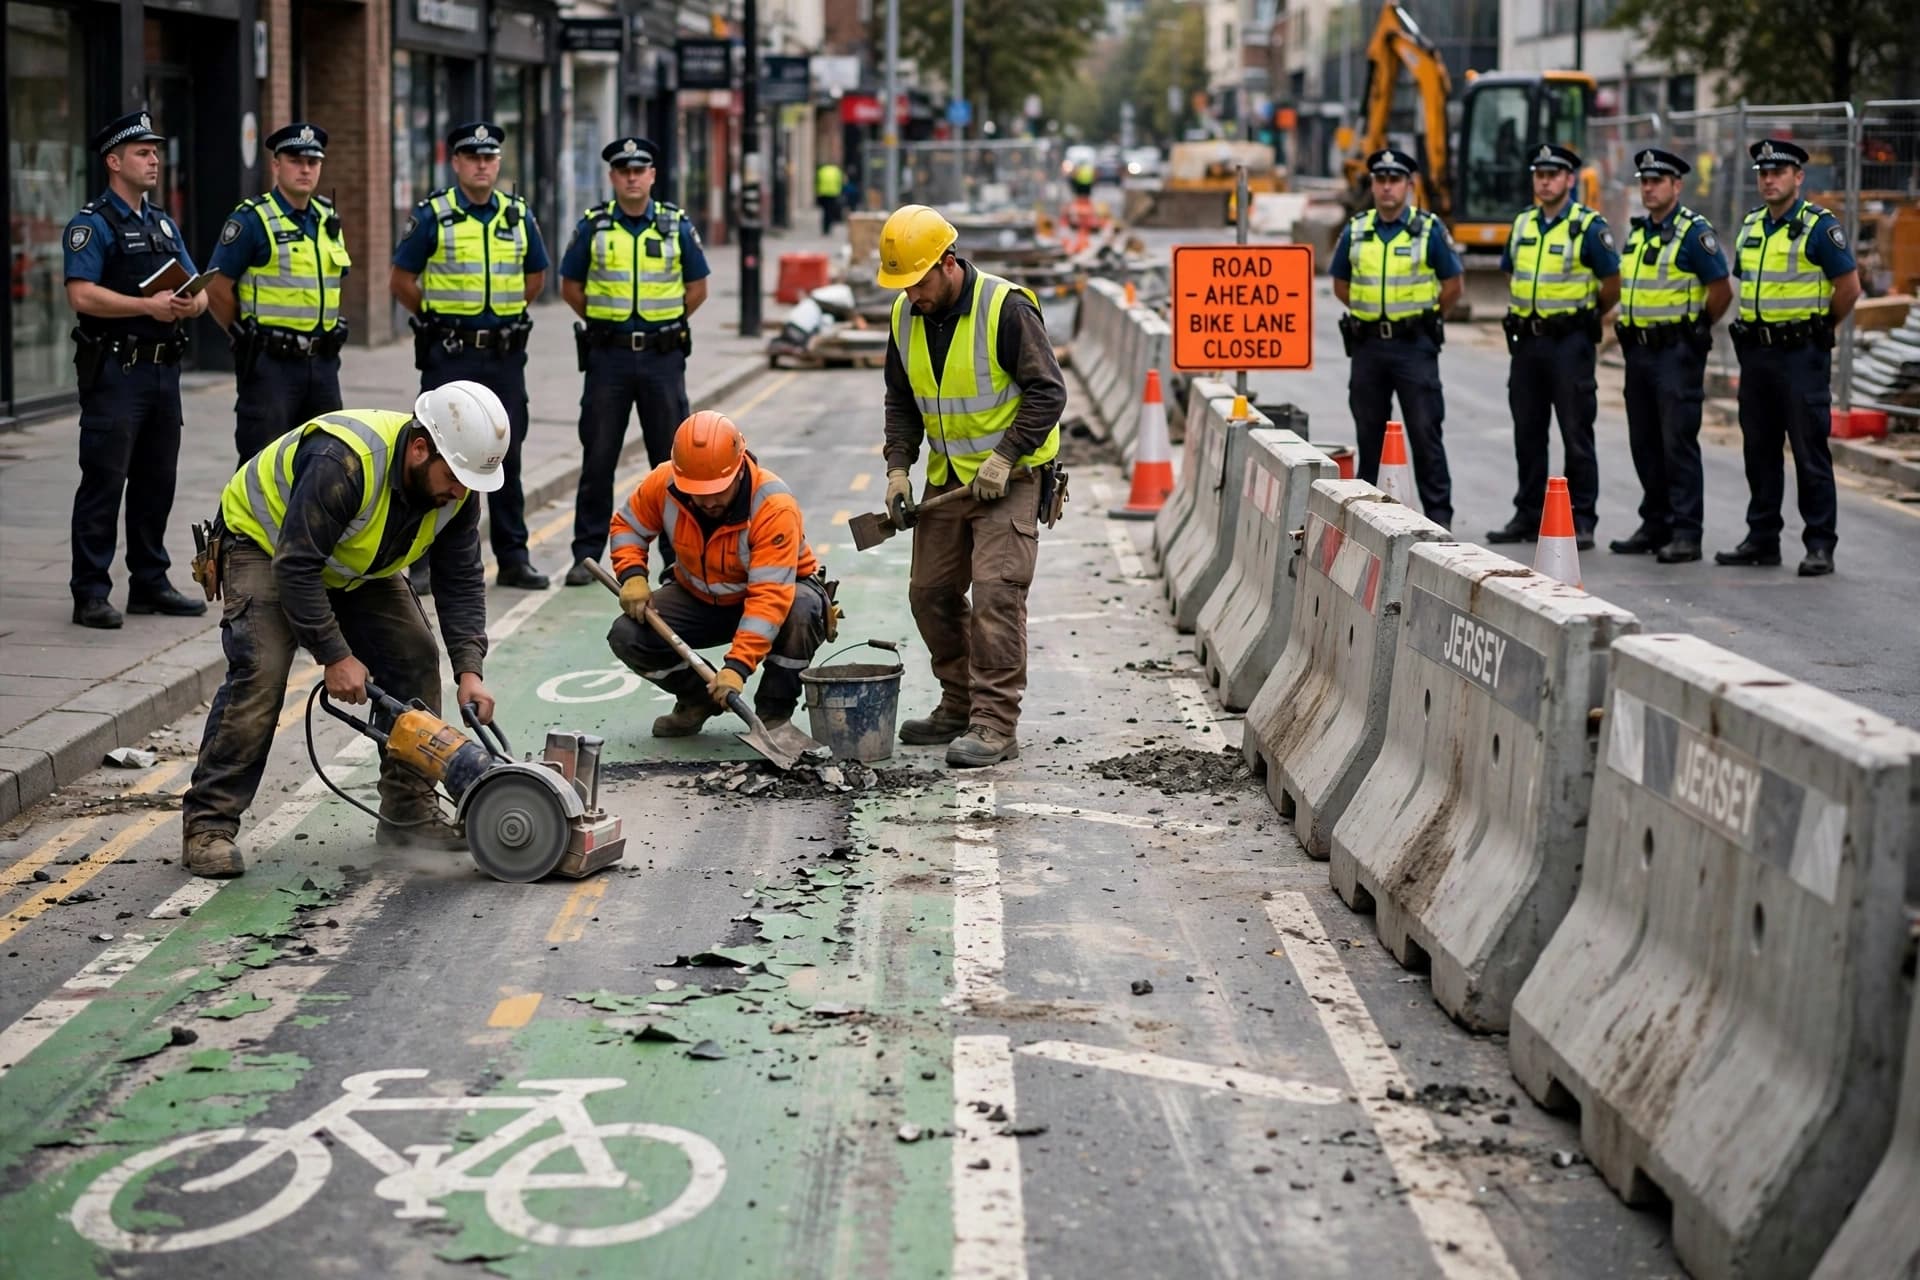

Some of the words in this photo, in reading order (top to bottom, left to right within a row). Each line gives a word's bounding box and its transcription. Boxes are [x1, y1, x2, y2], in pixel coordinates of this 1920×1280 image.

[1213, 257, 1272, 278] ROAD
[1205, 284, 1280, 305] AHEAD
[1190, 313, 1234, 333] BIKE
[1244, 313, 1297, 333] LANE
[1204, 339, 1282, 359] CLOSED
[1444, 613, 1507, 688] JERSEY
[1678, 740, 1762, 835] JERSEY
